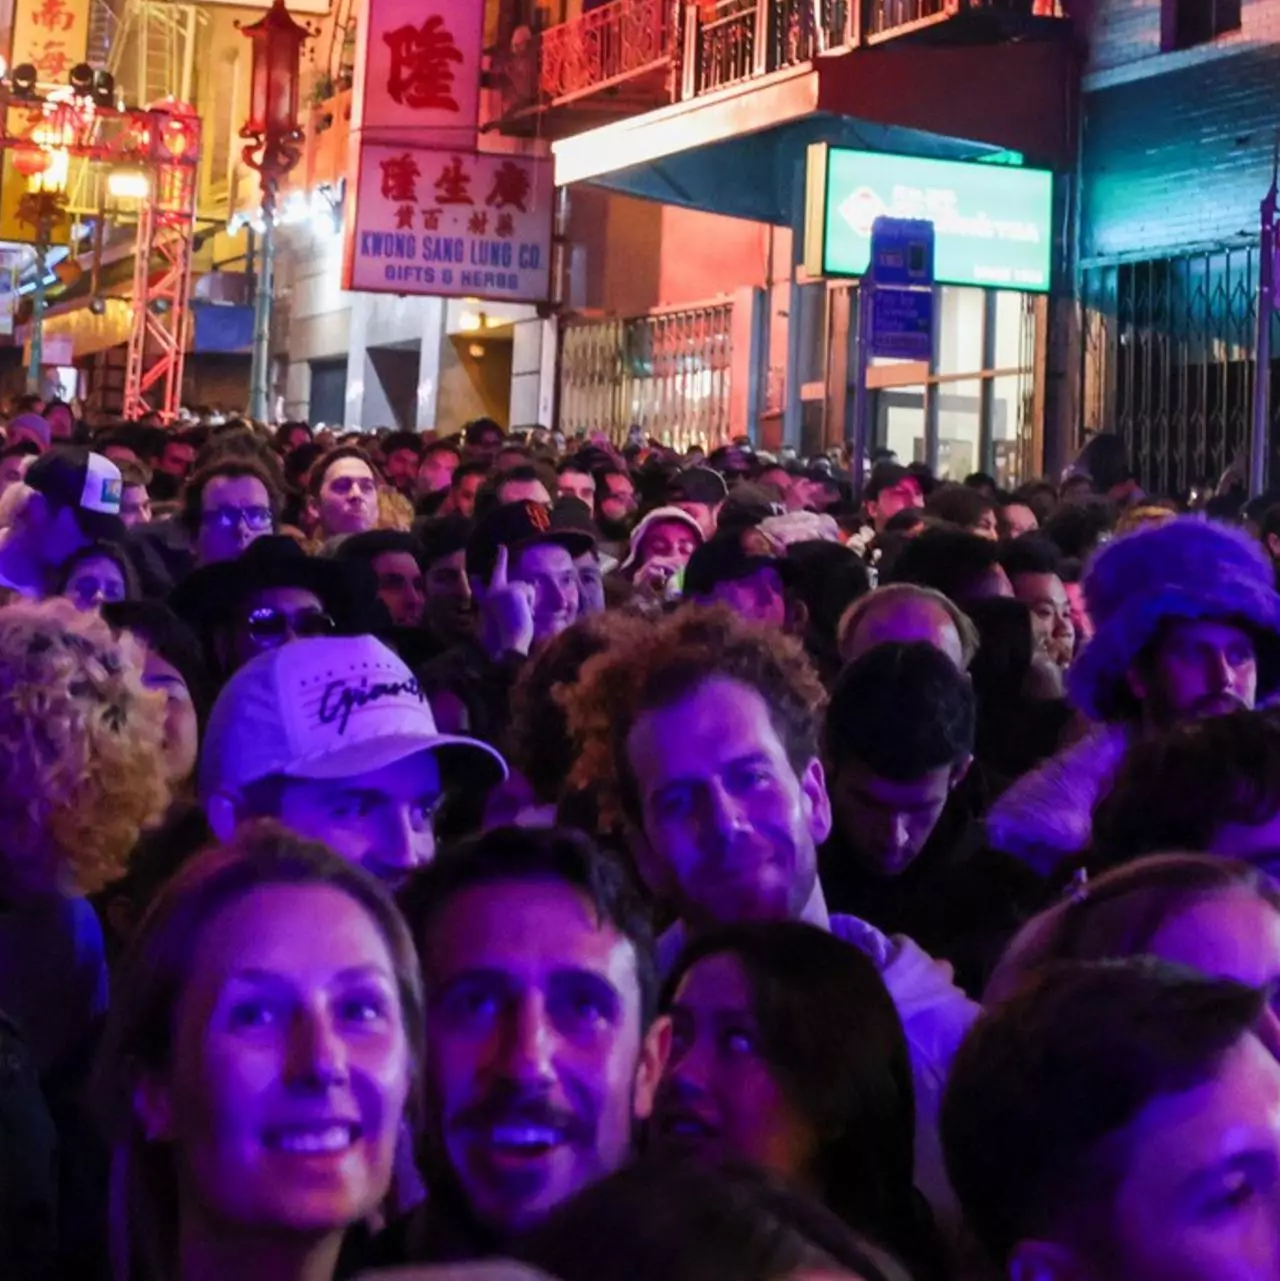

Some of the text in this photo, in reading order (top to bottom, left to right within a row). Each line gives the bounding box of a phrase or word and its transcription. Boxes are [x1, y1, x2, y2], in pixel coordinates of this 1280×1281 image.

[360, 230, 417, 260] KWONG
[422, 235, 465, 264] SANG
[470, 239, 513, 268] LUNG
[384, 264, 436, 284] GIFTS
[460, 271, 519, 291] HERBS
